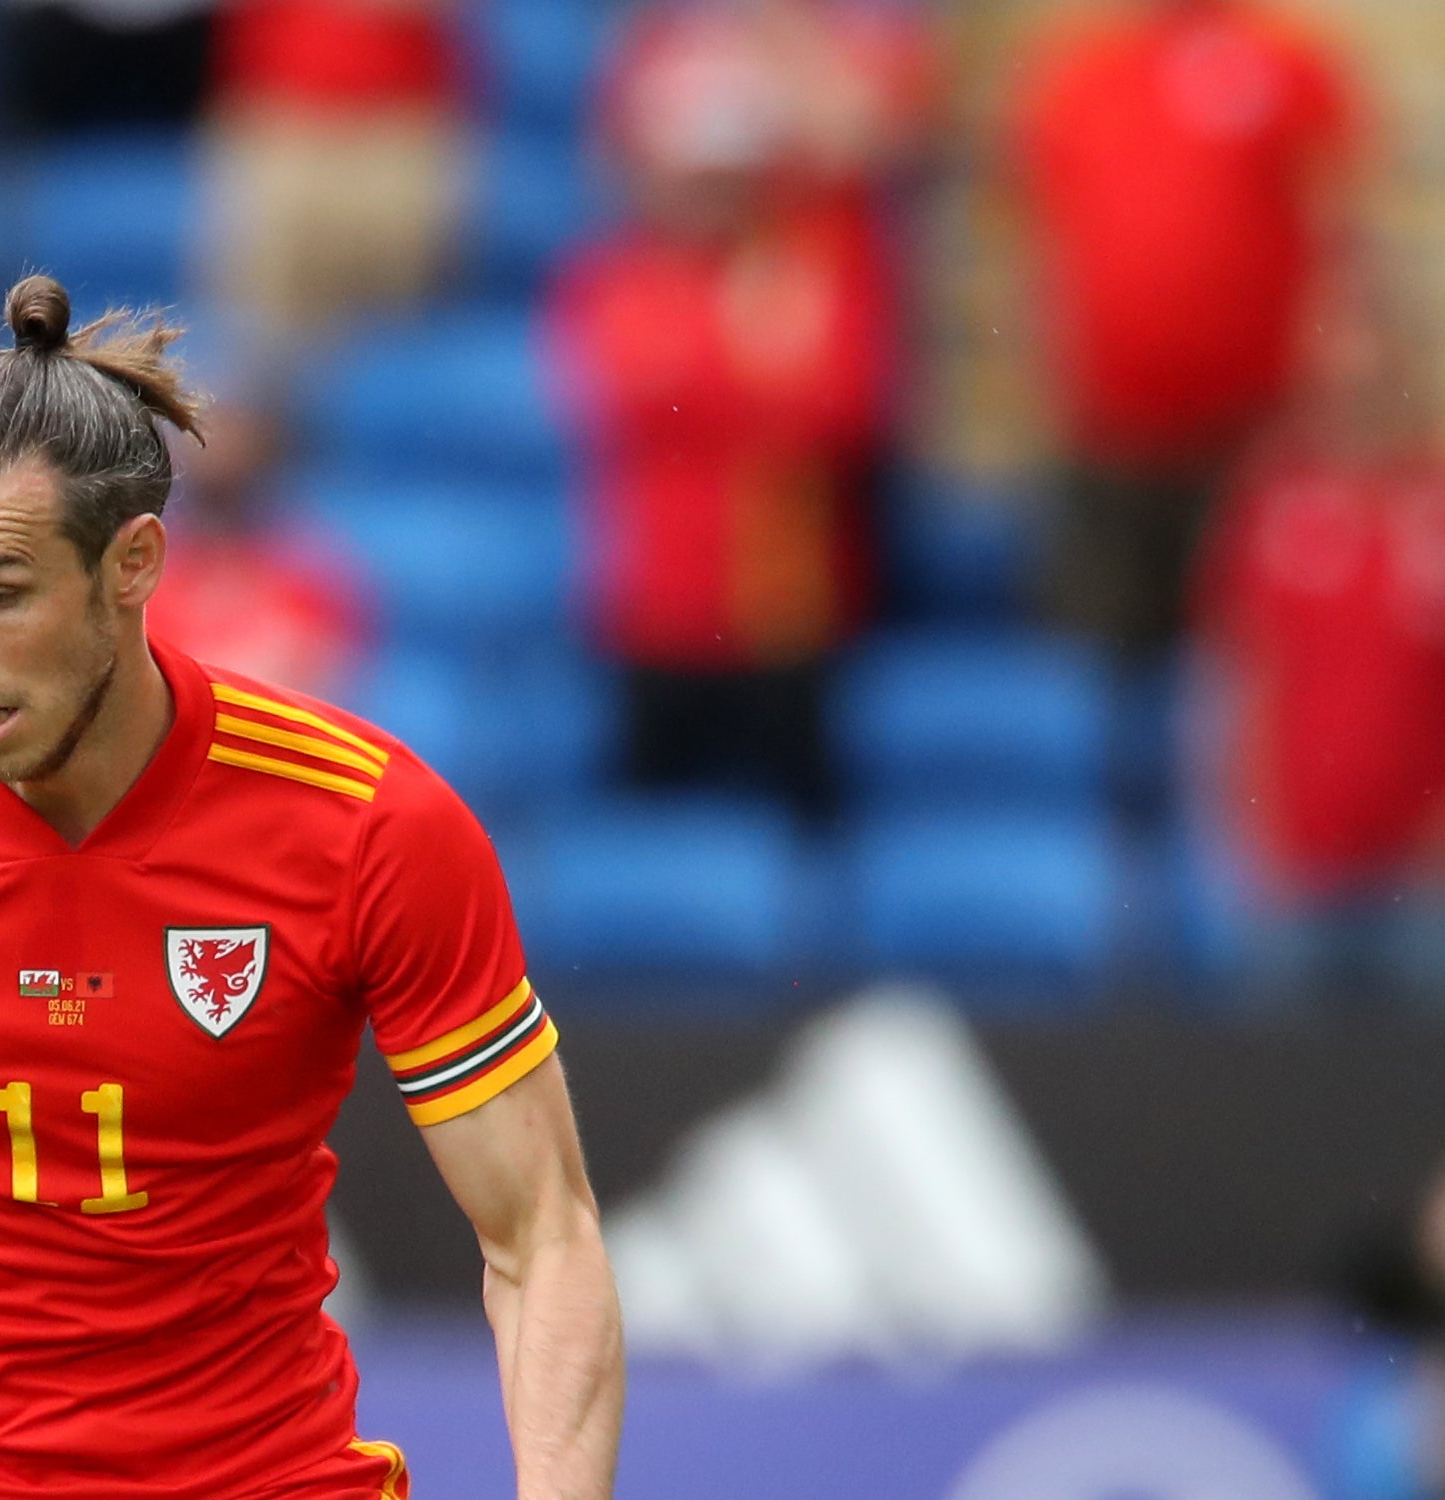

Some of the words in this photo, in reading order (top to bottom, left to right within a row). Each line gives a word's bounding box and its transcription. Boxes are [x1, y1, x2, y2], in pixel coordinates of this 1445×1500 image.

[60, 977, 74, 991] VS
[48, 999, 86, 1012] 05.06.21
[66, 1013, 84, 1026] 674
